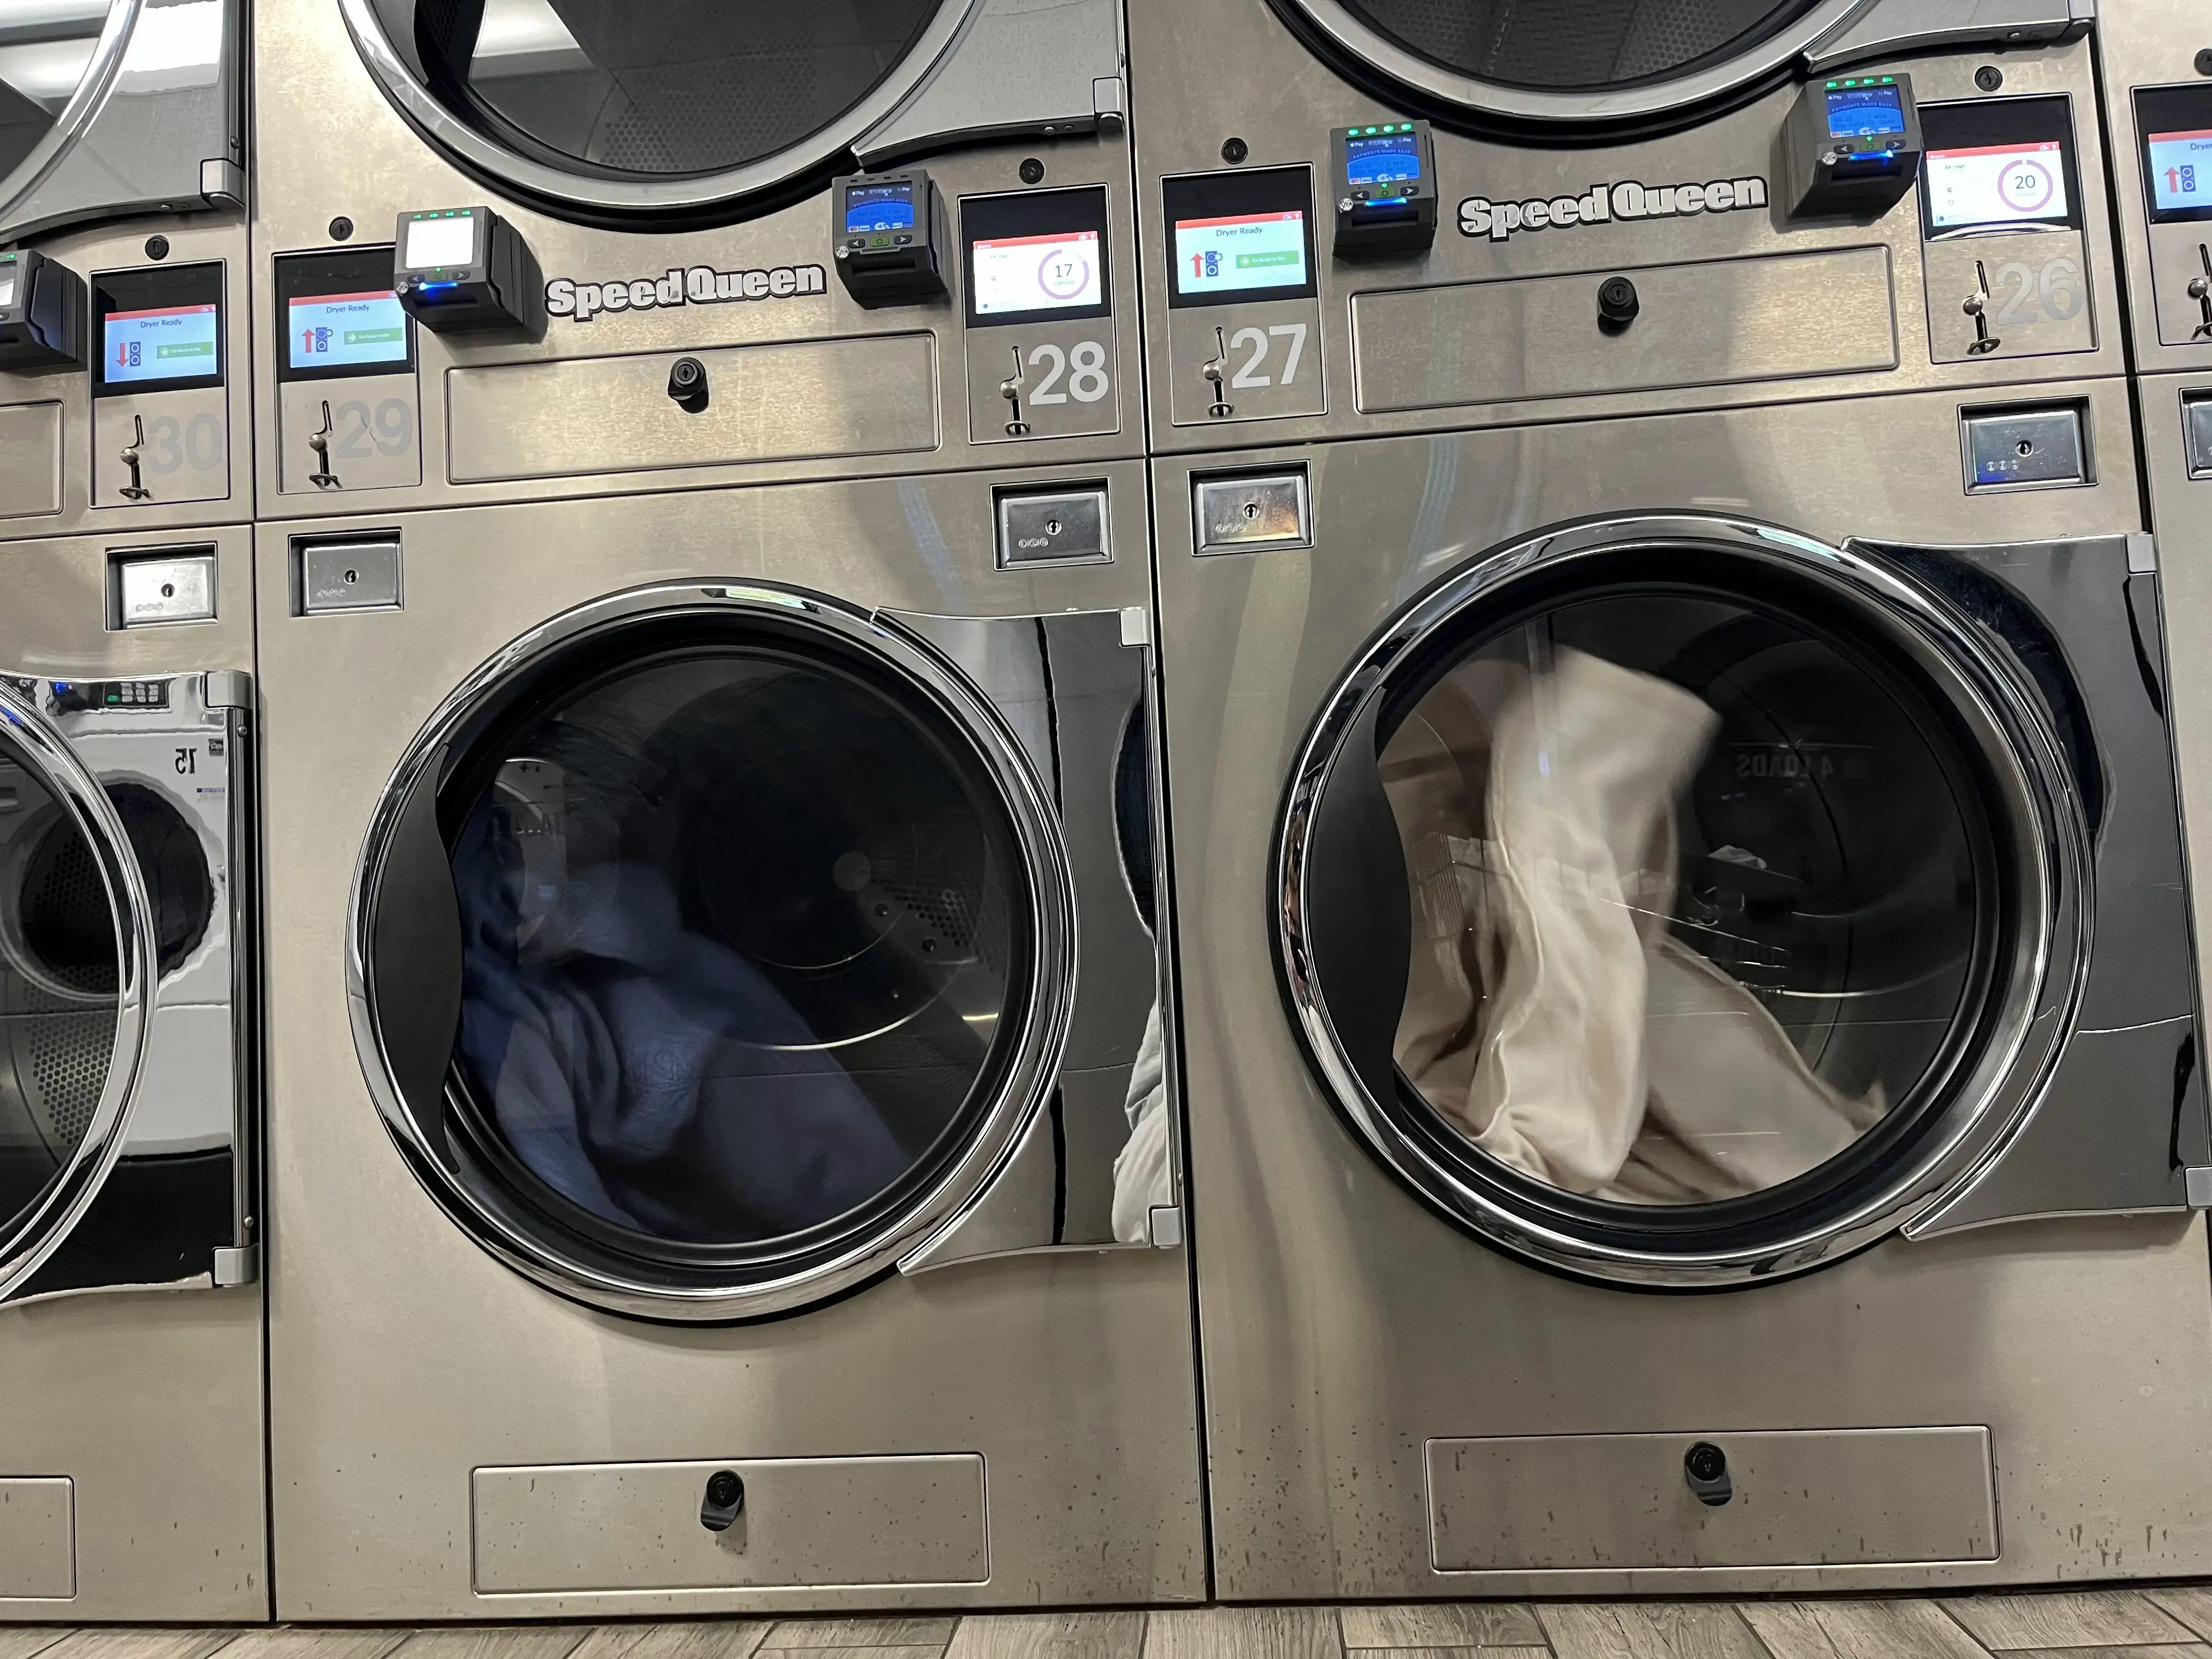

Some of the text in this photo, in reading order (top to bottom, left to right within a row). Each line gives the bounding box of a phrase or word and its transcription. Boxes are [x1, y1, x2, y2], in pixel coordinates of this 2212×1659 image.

[1457, 176, 1769, 243] Speed Queen
[2015, 175, 2036, 189] 20
[1216, 227, 1263, 237] Dryer Ready
[545, 264, 827, 323] Speed Queen
[1055, 263, 1073, 278] 17
[1994, 257, 2084, 327] 26
[326, 306, 346, 314] Dryer
[1029, 341, 1109, 405] 28
[1230, 323, 1307, 388] 27
[146, 413, 223, 475] 30
[335, 398, 414, 459] 29
